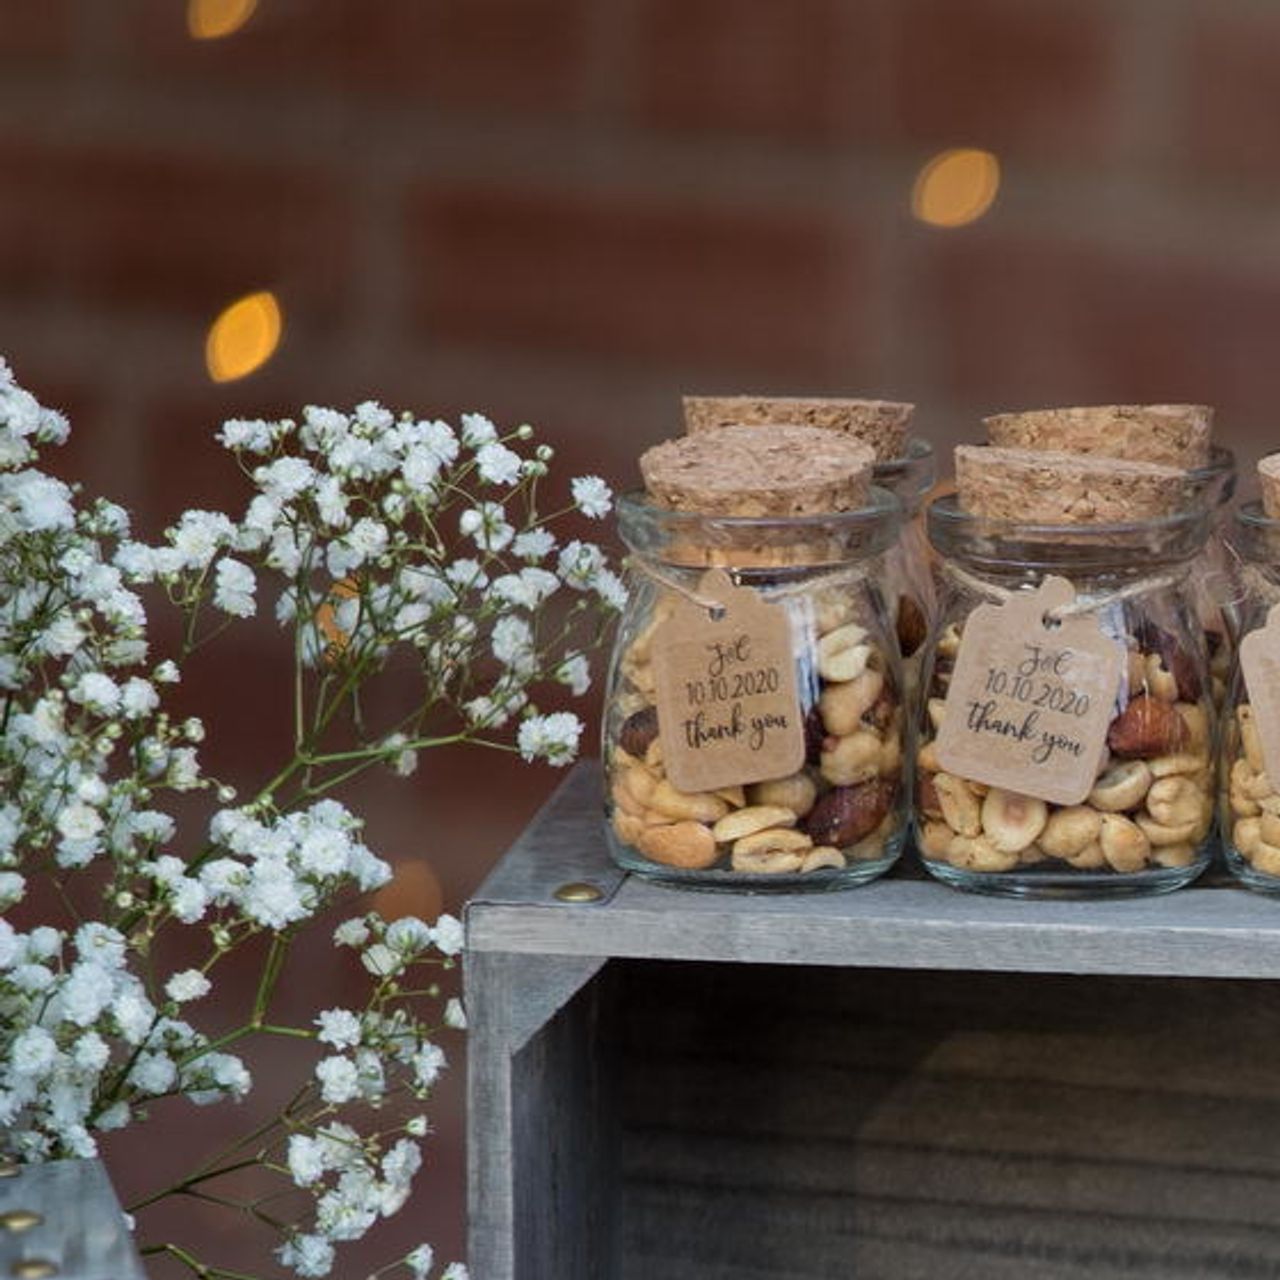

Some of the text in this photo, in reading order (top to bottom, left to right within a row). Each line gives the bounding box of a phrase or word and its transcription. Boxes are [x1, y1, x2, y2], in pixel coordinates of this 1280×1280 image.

[686, 667, 779, 705] 10.10.2020
[985, 668, 1090, 718] 10.10.2020
[681, 702, 788, 751] thank you
[966, 700, 1086, 764] thank you
